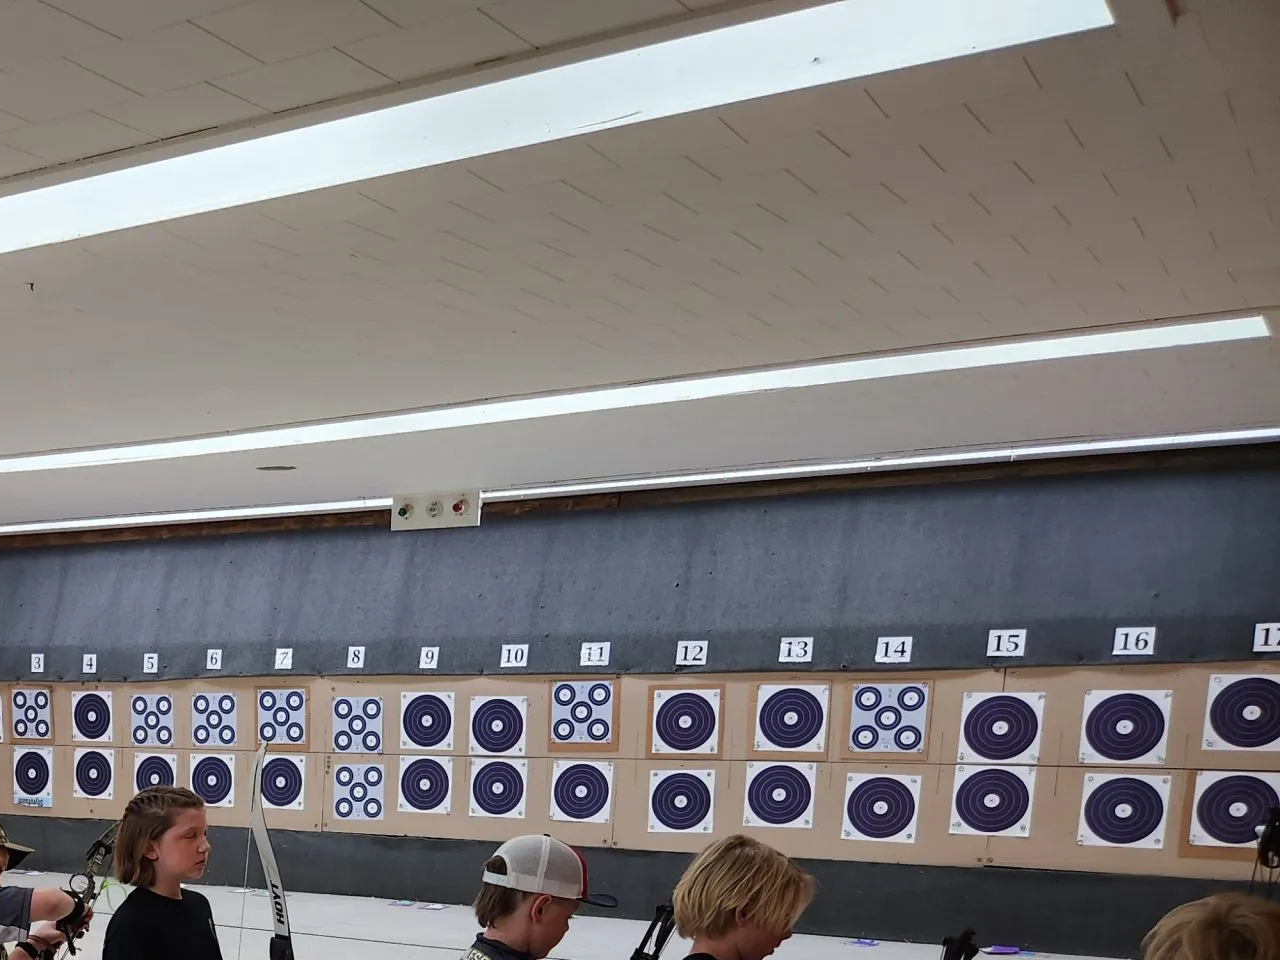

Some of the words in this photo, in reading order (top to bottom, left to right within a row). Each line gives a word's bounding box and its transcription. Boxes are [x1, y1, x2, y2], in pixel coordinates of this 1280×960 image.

[993, 634, 1021, 653] 15
[1118, 631, 1149, 651] 16
[352, 649, 360, 664] 8
[505, 648, 524, 664] 10
[585, 647, 605, 662] 11
[681, 645, 704, 662] 12
[784, 640, 808, 658] 13
[882, 640, 907, 659] 14
[34, 657, 41, 669] 3
[86, 657, 93, 670] 4
[147, 657, 154, 669] 5
[210, 652, 218, 666] 6
[280, 652, 289, 665] 7
[424, 650, 434, 665] 9
[269, 879, 285, 926] HOYT
